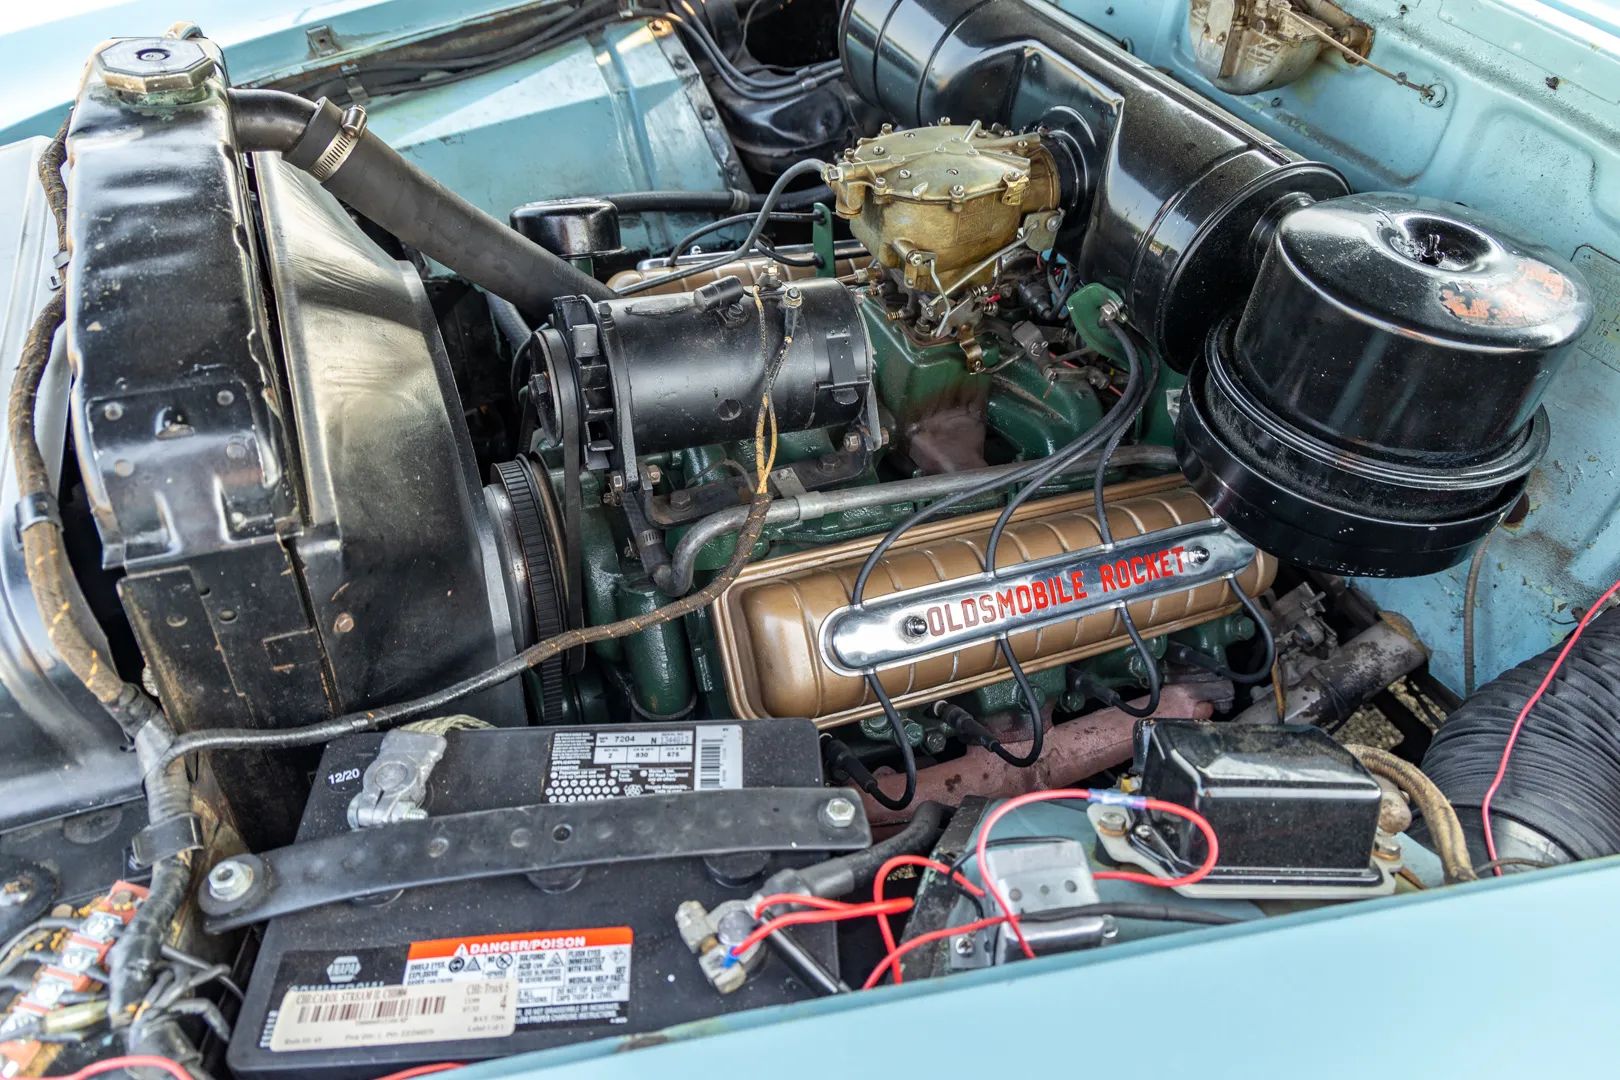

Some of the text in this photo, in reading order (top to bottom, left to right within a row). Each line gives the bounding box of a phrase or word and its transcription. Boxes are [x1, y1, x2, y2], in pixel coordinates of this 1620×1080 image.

[927, 546, 1186, 637] OLDSMOBILE ROCKET
[614, 735, 636, 743] 7204
[650, 736, 657, 745] N
[328, 768, 360, 785] 12/20
[470, 936, 586, 954] DANGER/POISON
[568, 976, 592, 984] MEDICAL
